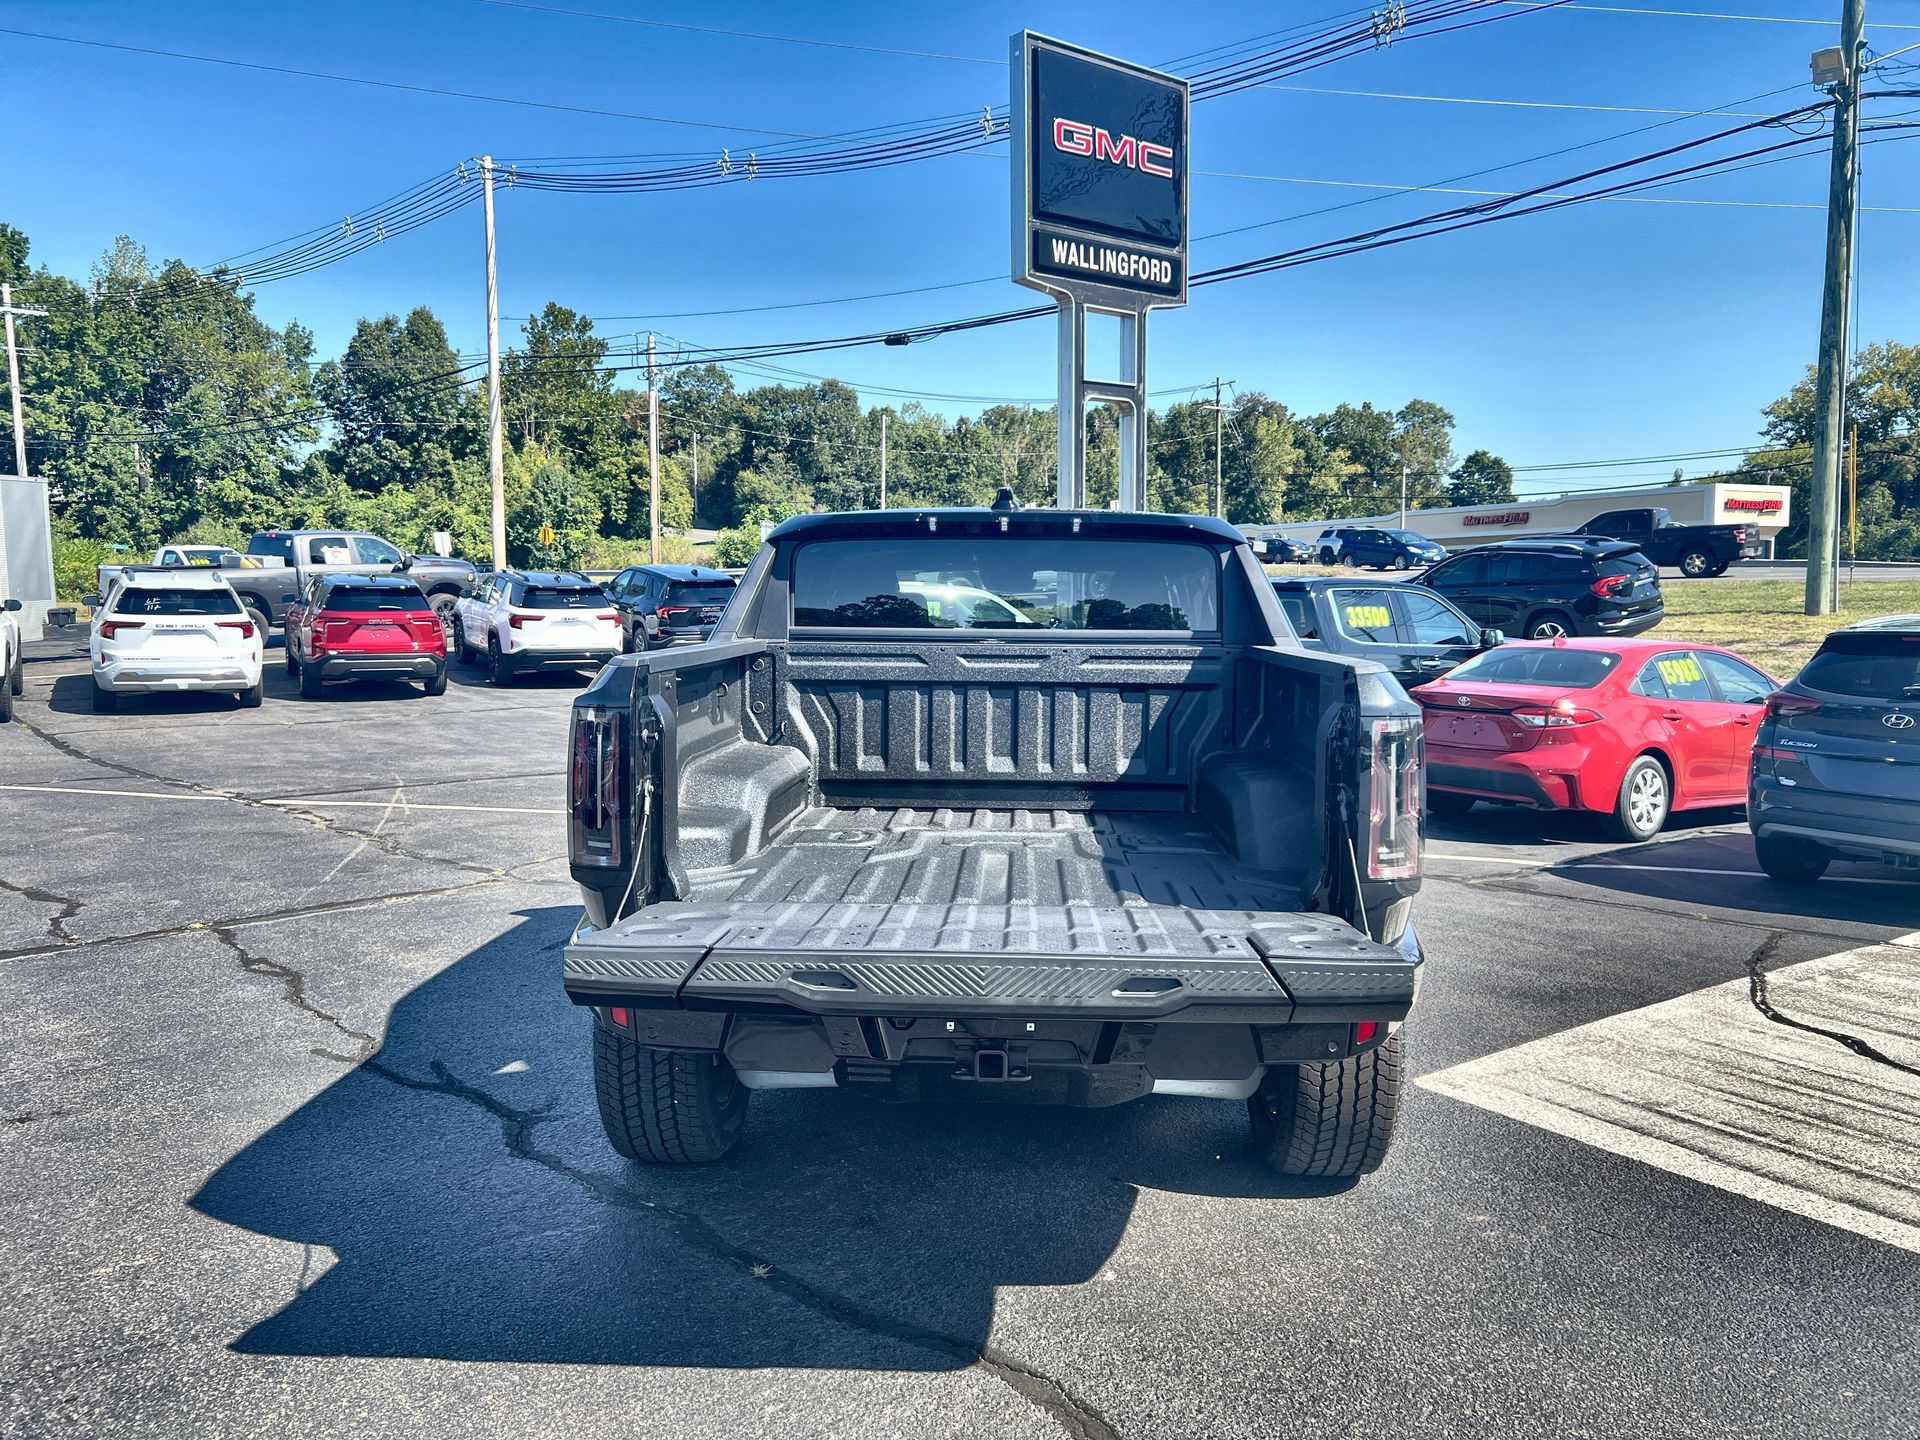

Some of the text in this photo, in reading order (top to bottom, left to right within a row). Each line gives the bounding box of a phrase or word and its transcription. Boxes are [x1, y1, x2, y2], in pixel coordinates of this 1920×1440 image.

[1053, 117, 1173, 178] GMC
[1052, 239, 1172, 284] WALLINGFORD
[1346, 605, 1390, 628] 33500
[1657, 657, 1702, 686] 15988
[1779, 738, 1818, 749] TUCSON
